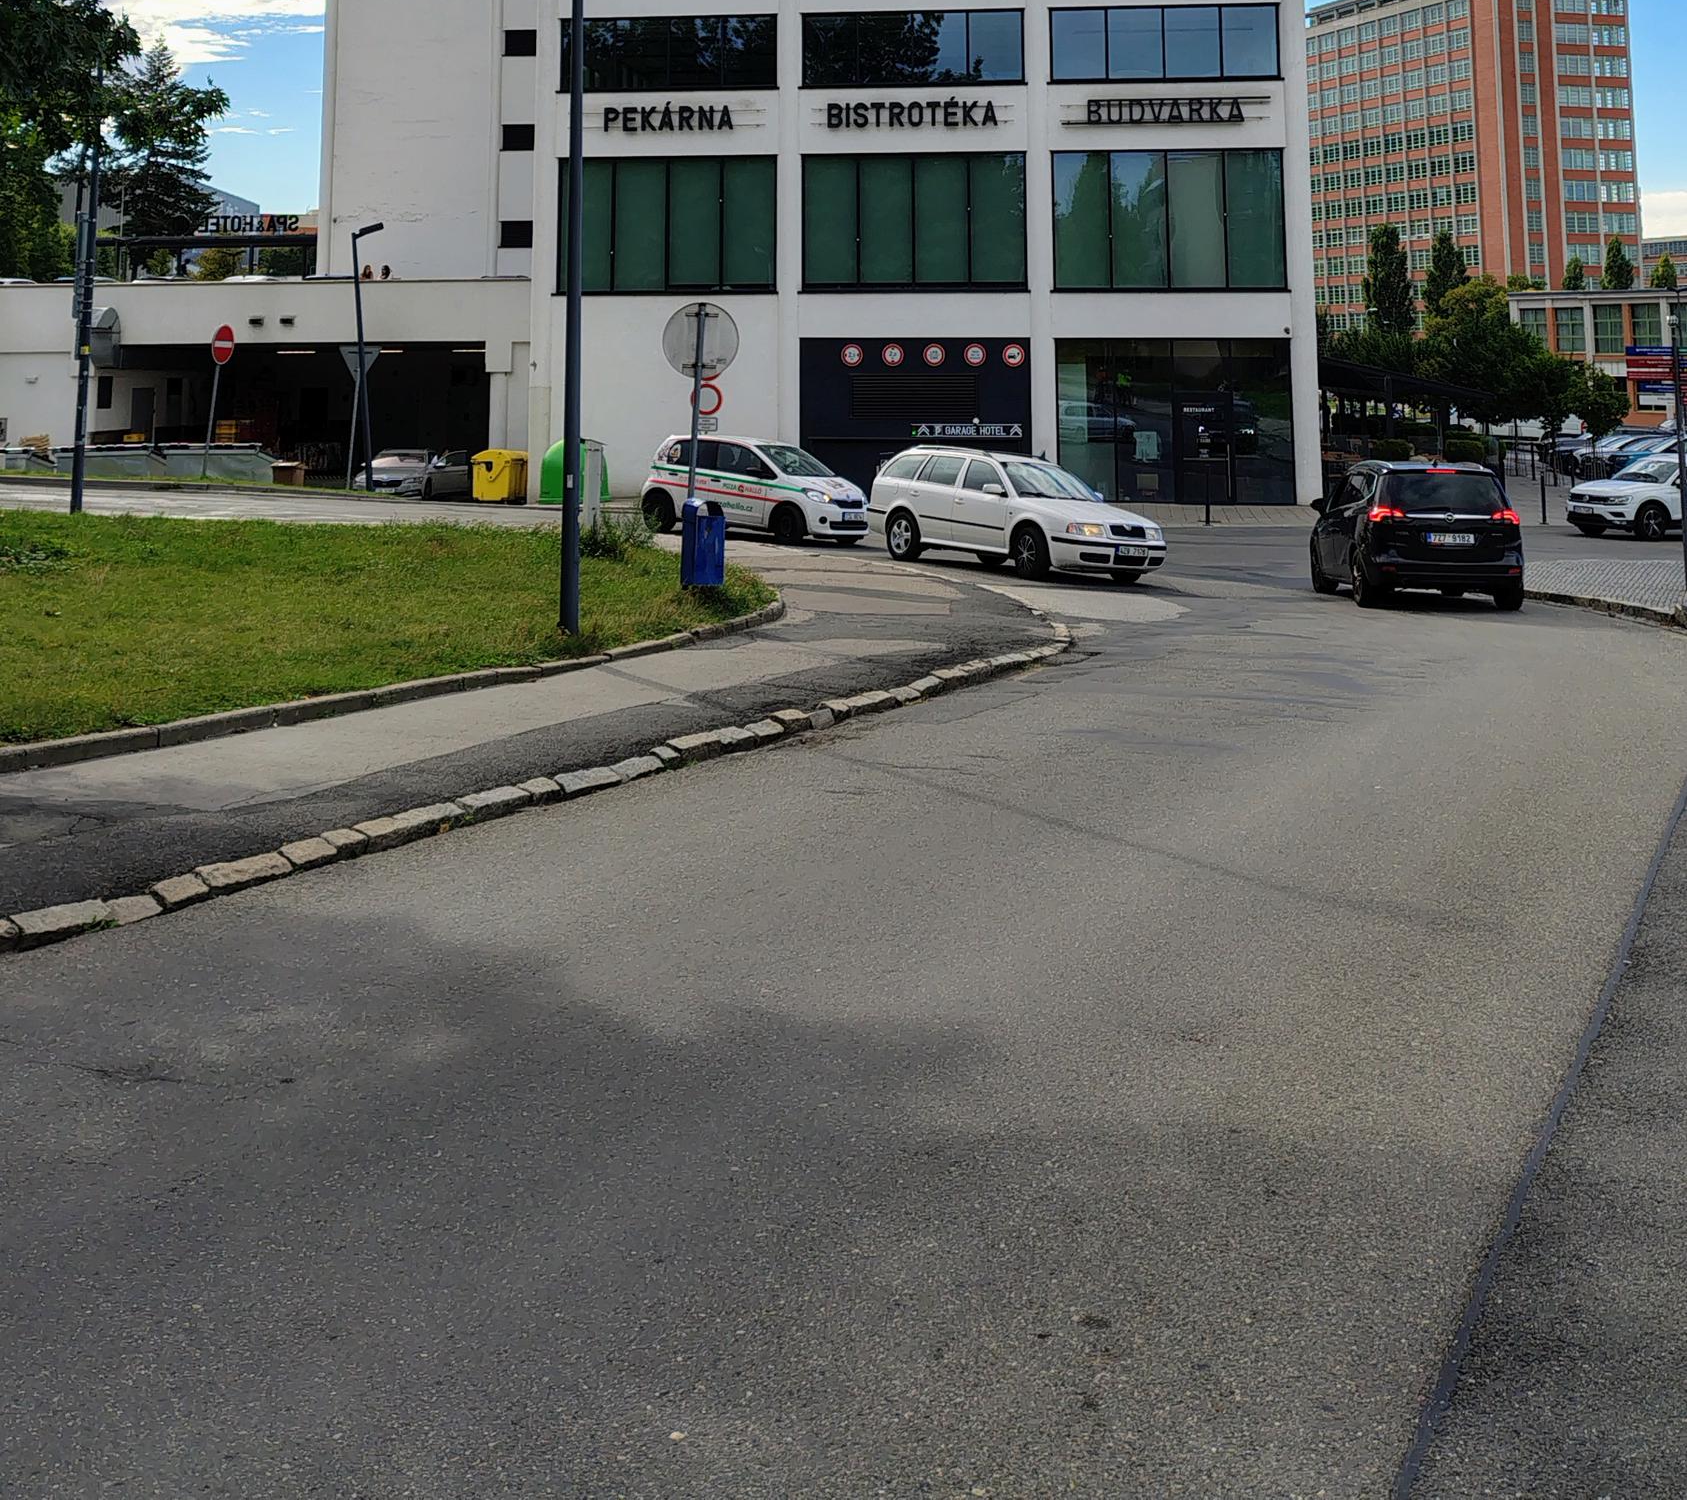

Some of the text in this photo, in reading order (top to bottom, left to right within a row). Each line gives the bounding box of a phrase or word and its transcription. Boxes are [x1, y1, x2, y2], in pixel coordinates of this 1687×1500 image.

[603, 101, 734, 132] PEKÁRNA
[827, 96, 998, 129] BISTROTÉKA
[1087, 97, 1245, 125] BUDVARKA
[945, 426, 977, 435] GARAGE
[979, 426, 1006, 436] HOTEL
[1452, 534, 1471, 543] 9182
